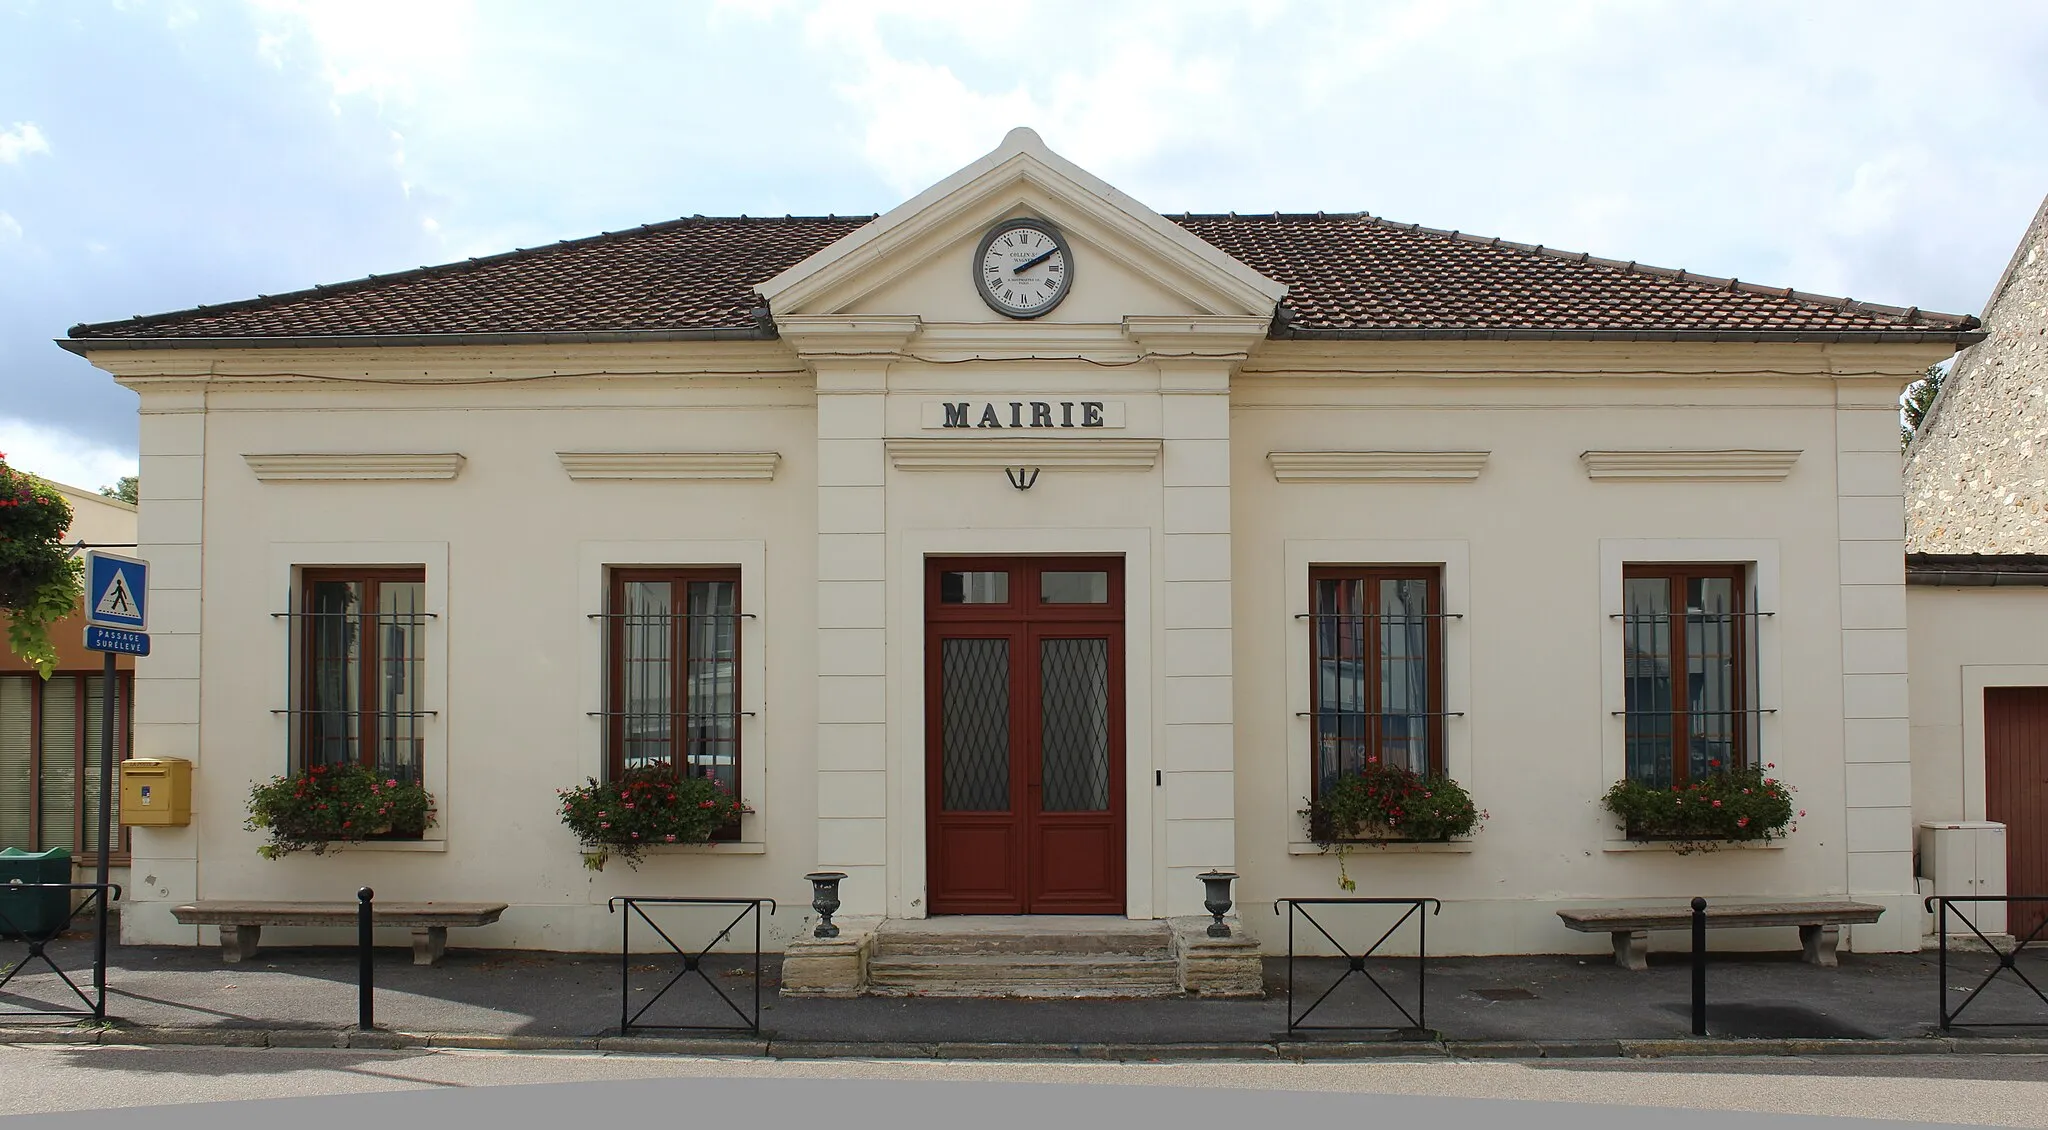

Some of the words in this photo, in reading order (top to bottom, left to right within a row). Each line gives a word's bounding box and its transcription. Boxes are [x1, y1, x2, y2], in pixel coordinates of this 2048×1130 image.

[942, 402, 1104, 428] MAIRIE
[98, 630, 139, 641] PASSAGE
[96, 640, 140, 651] SURÉLEVÉ
